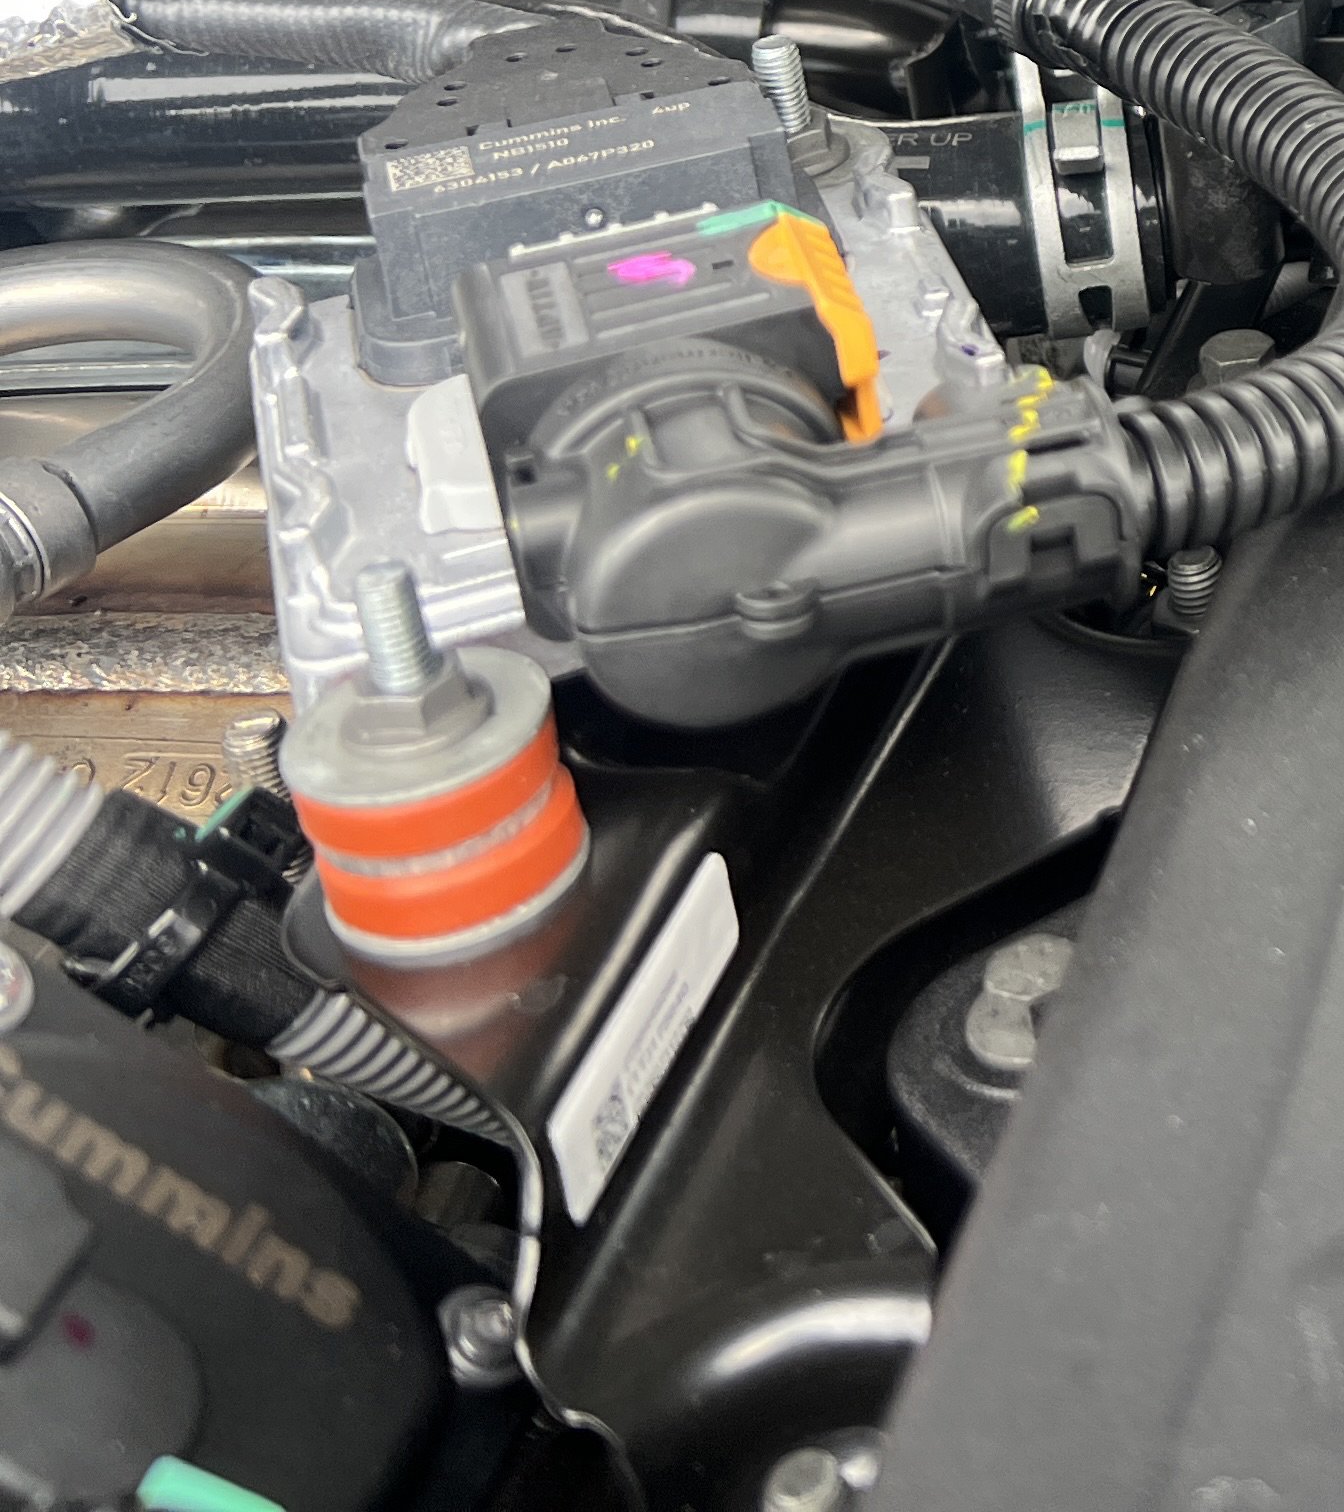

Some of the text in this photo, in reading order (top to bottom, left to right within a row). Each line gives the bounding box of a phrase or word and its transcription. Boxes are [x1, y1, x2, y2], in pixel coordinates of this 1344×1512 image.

[480, 116, 627, 150] Cummins Inc.
[930, 132, 974, 146] UP
